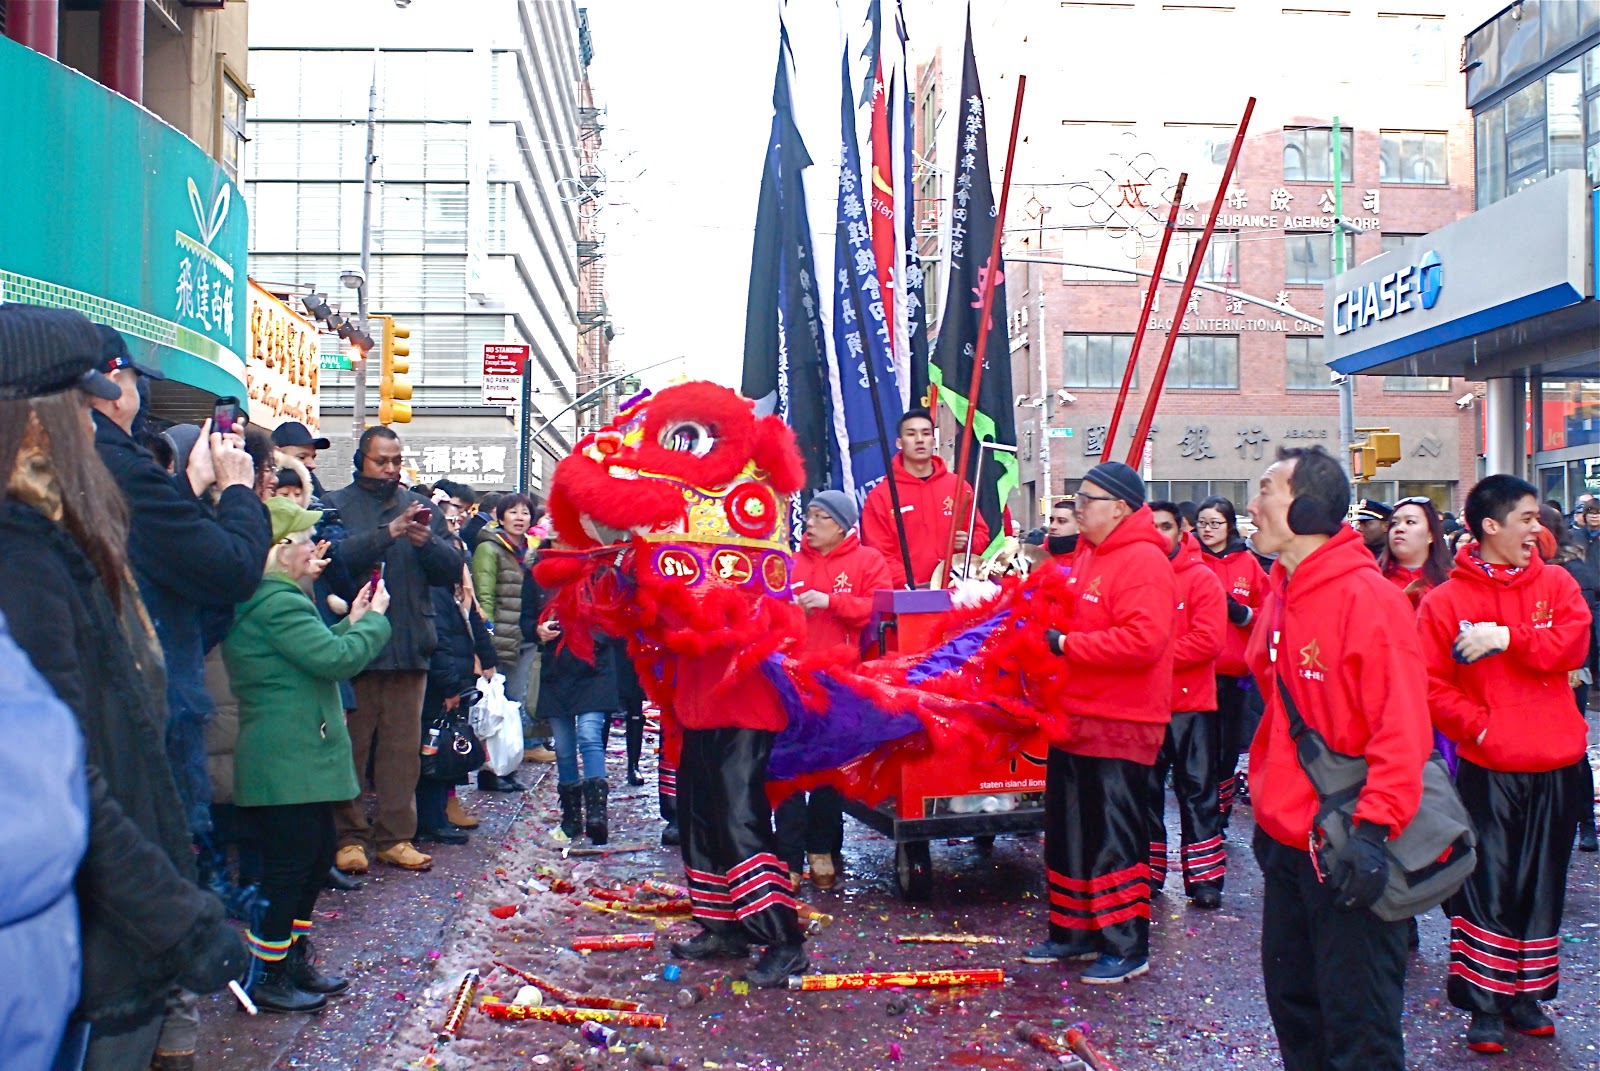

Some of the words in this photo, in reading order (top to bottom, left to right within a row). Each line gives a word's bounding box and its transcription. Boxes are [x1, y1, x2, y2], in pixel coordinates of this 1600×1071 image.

[871, 197, 894, 220] aten
[1333, 265, 1416, 335] CHASE
[1196, 318, 1290, 331] INTERNATIONAL
[495, 346, 524, 354] STANDING
[320, 355, 341, 365] ANAL
[1283, 429, 1328, 439] ABACUS
[401, 445, 507, 473] 六福珠寶
[664, 556, 694, 576] SIL
[979, 780, 1004, 790] staten
[1005, 779, 1028, 789] island
[1028, 778, 1046, 788] lions
